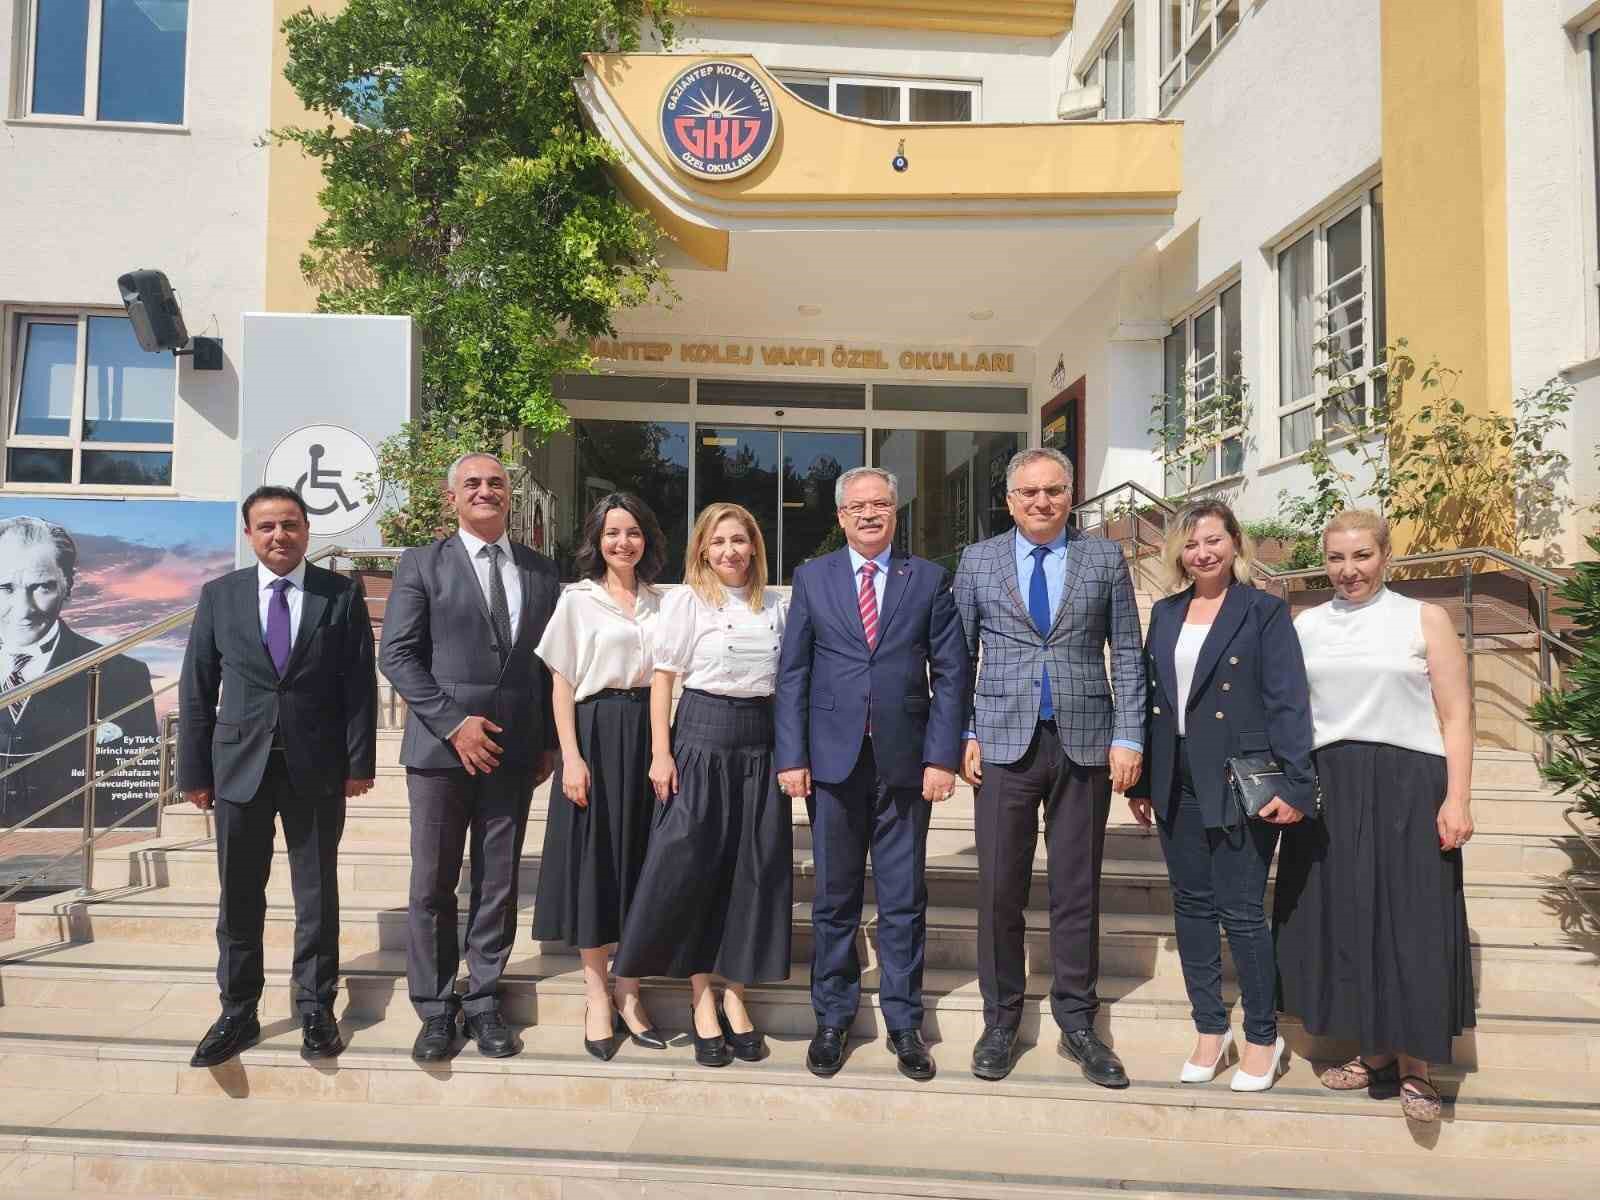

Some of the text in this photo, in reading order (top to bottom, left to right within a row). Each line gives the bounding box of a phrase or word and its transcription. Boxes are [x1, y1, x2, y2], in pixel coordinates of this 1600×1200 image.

[716, 65, 750, 84] KOLEJ
[750, 81, 769, 112] VAKFI
[674, 118, 761, 160] GKV
[682, 152, 754, 173] ÖZEL OKULLARI
[680, 343, 753, 365] KOLEJ
[761, 345, 825, 366] VAKFI
[832, 344, 889, 369] ÖZEL
[899, 350, 1016, 372] OKULLARI
[123, 735, 133, 746] Ey
[136, 735, 154, 744] Türk
